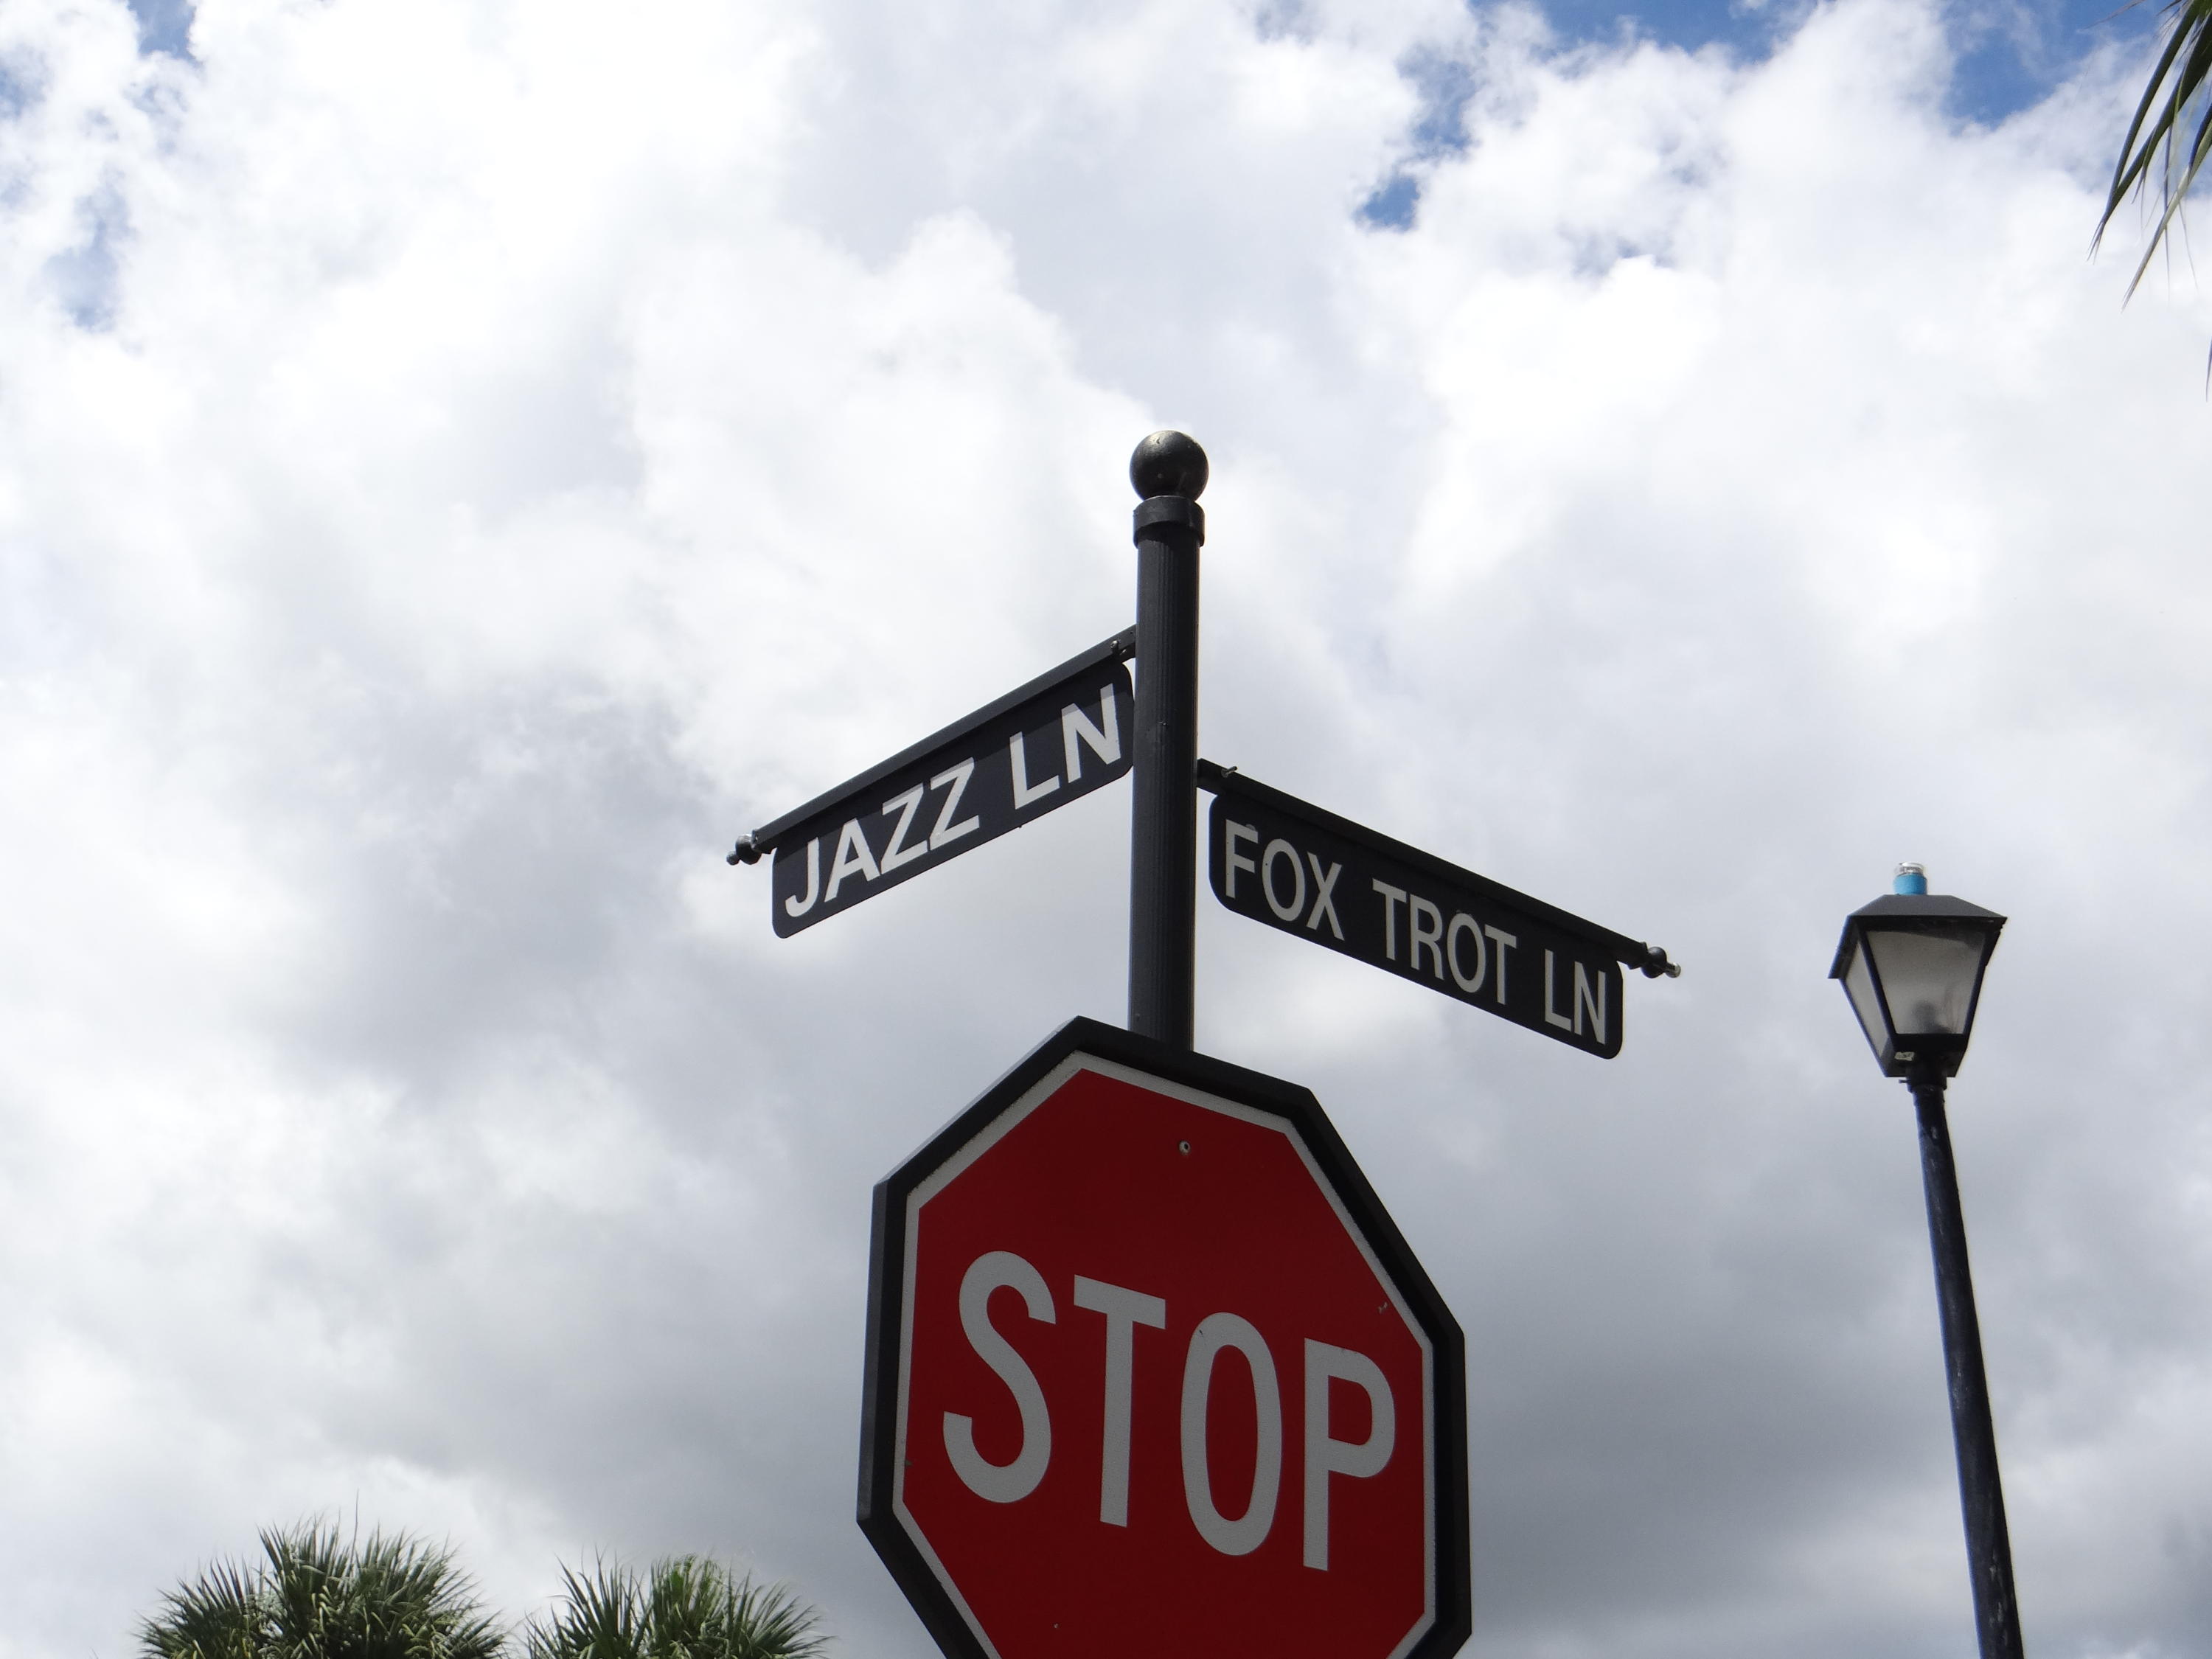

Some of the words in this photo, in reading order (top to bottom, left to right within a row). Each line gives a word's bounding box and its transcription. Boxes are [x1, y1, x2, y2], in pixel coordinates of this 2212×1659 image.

[785, 757, 980, 917] JAZZ
[1009, 683, 1121, 810] LN
[1225, 819, 1345, 941] FOX
[1372, 878, 1517, 1006] TROT
[1544, 949, 1606, 1045] LN
[942, 1251, 1395, 1571] STOP
